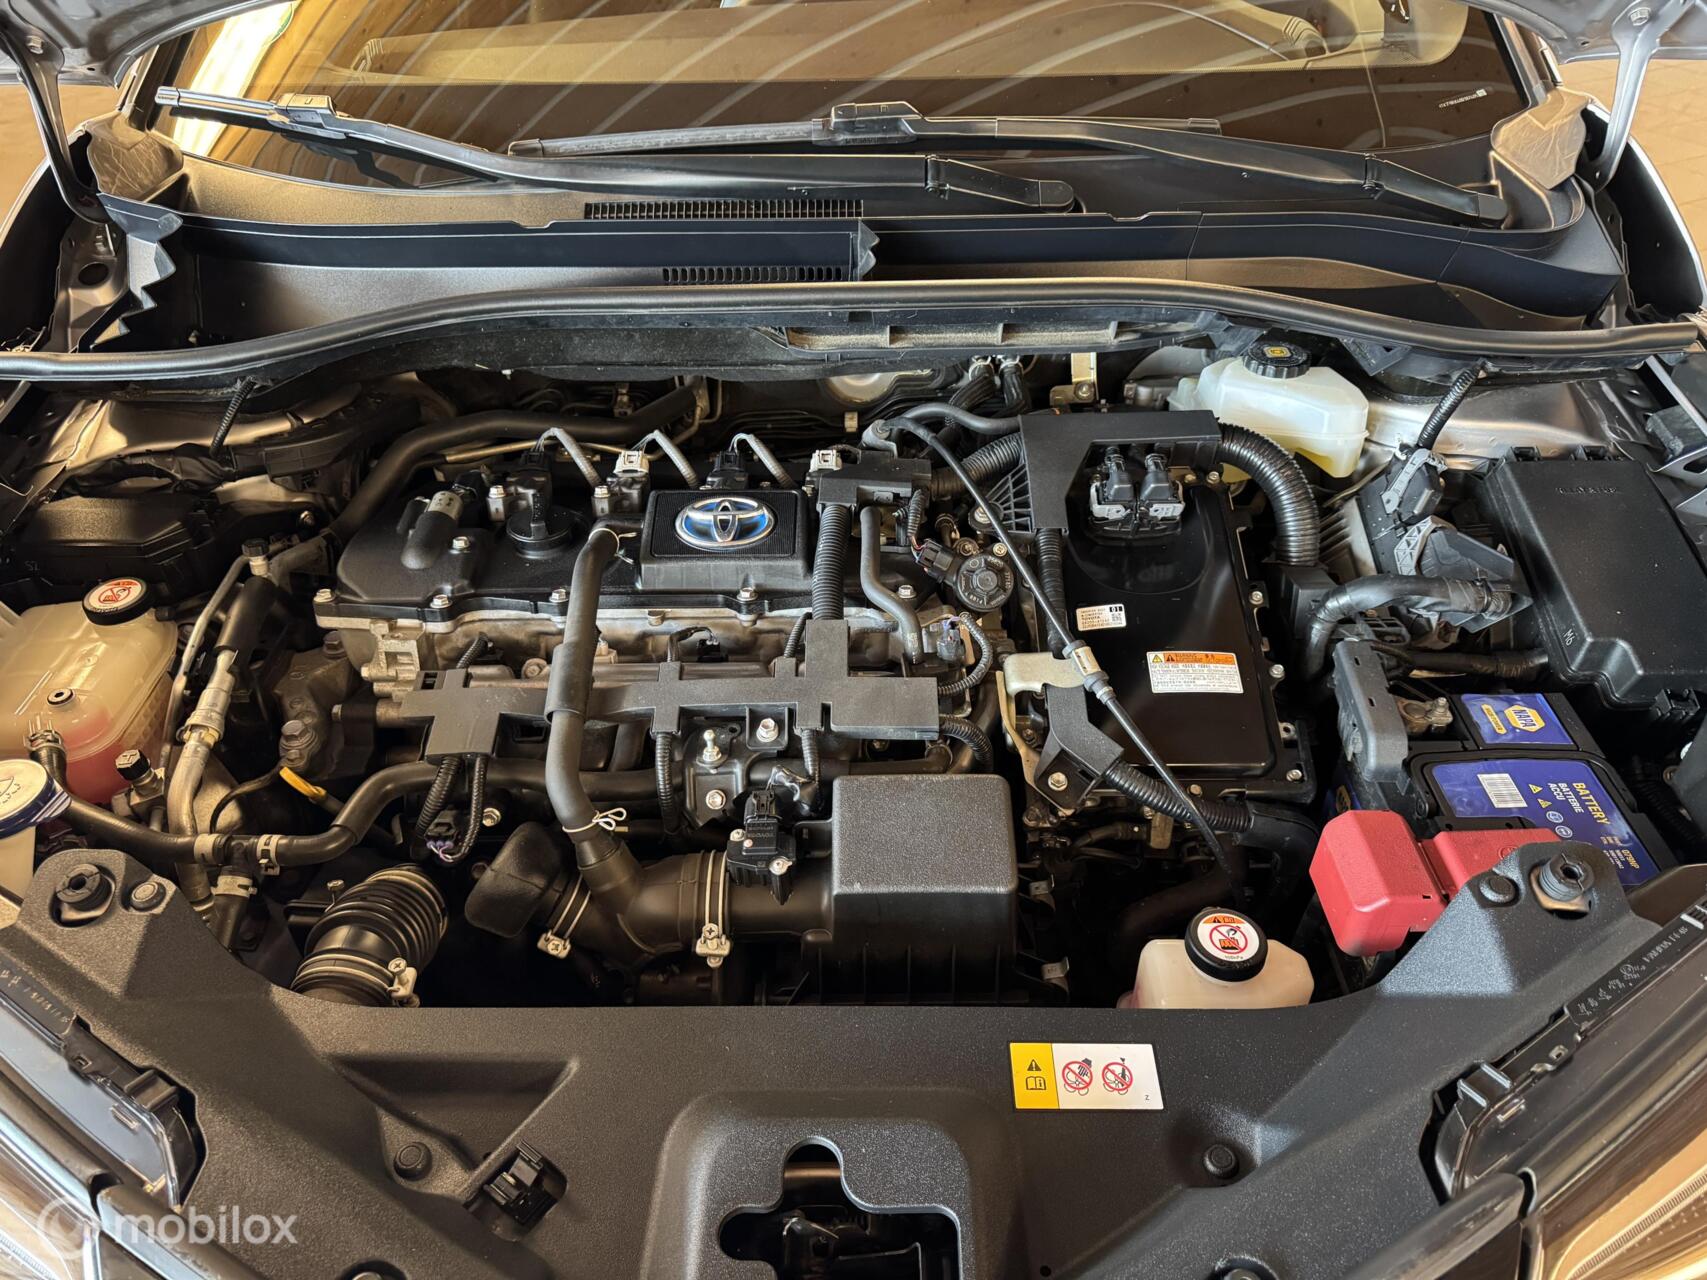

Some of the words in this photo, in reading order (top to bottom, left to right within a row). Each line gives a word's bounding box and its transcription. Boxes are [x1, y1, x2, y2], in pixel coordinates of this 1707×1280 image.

[1511, 708, 1537, 728] NAPA
[1547, 782, 1566, 801] ACCU
[1557, 782, 1585, 814] BATTERIE
[1572, 782, 1611, 826] BATTERY
